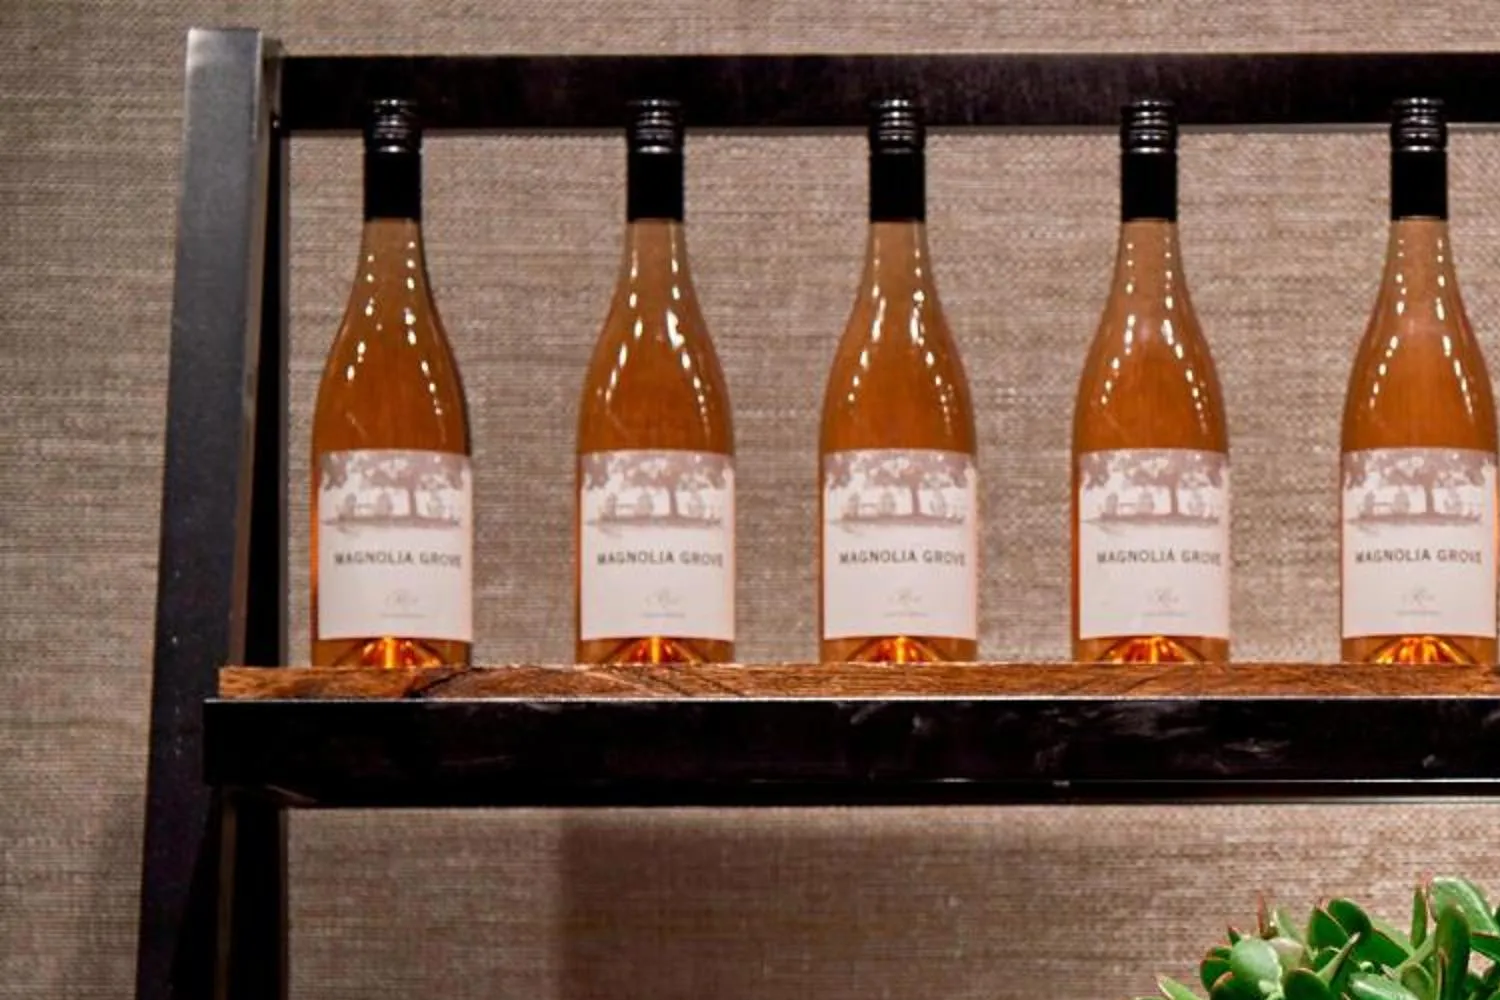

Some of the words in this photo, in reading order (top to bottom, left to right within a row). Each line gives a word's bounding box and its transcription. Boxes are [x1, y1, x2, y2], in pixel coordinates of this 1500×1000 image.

[334, 551, 414, 566] MAGNOLIA
[419, 552, 461, 568] GROVE
[596, 551, 675, 566] MAGNOLIA
[679, 551, 723, 568] GROVE
[839, 549, 918, 565] MAGNOLIA
[922, 550, 966, 567] GROVE
[1096, 548, 1176, 564] MAGNOLIA
[1180, 550, 1221, 566] GROVE
[1355, 548, 1432, 564] MAGNOLIA
[1436, 548, 1482, 564] GROVE
